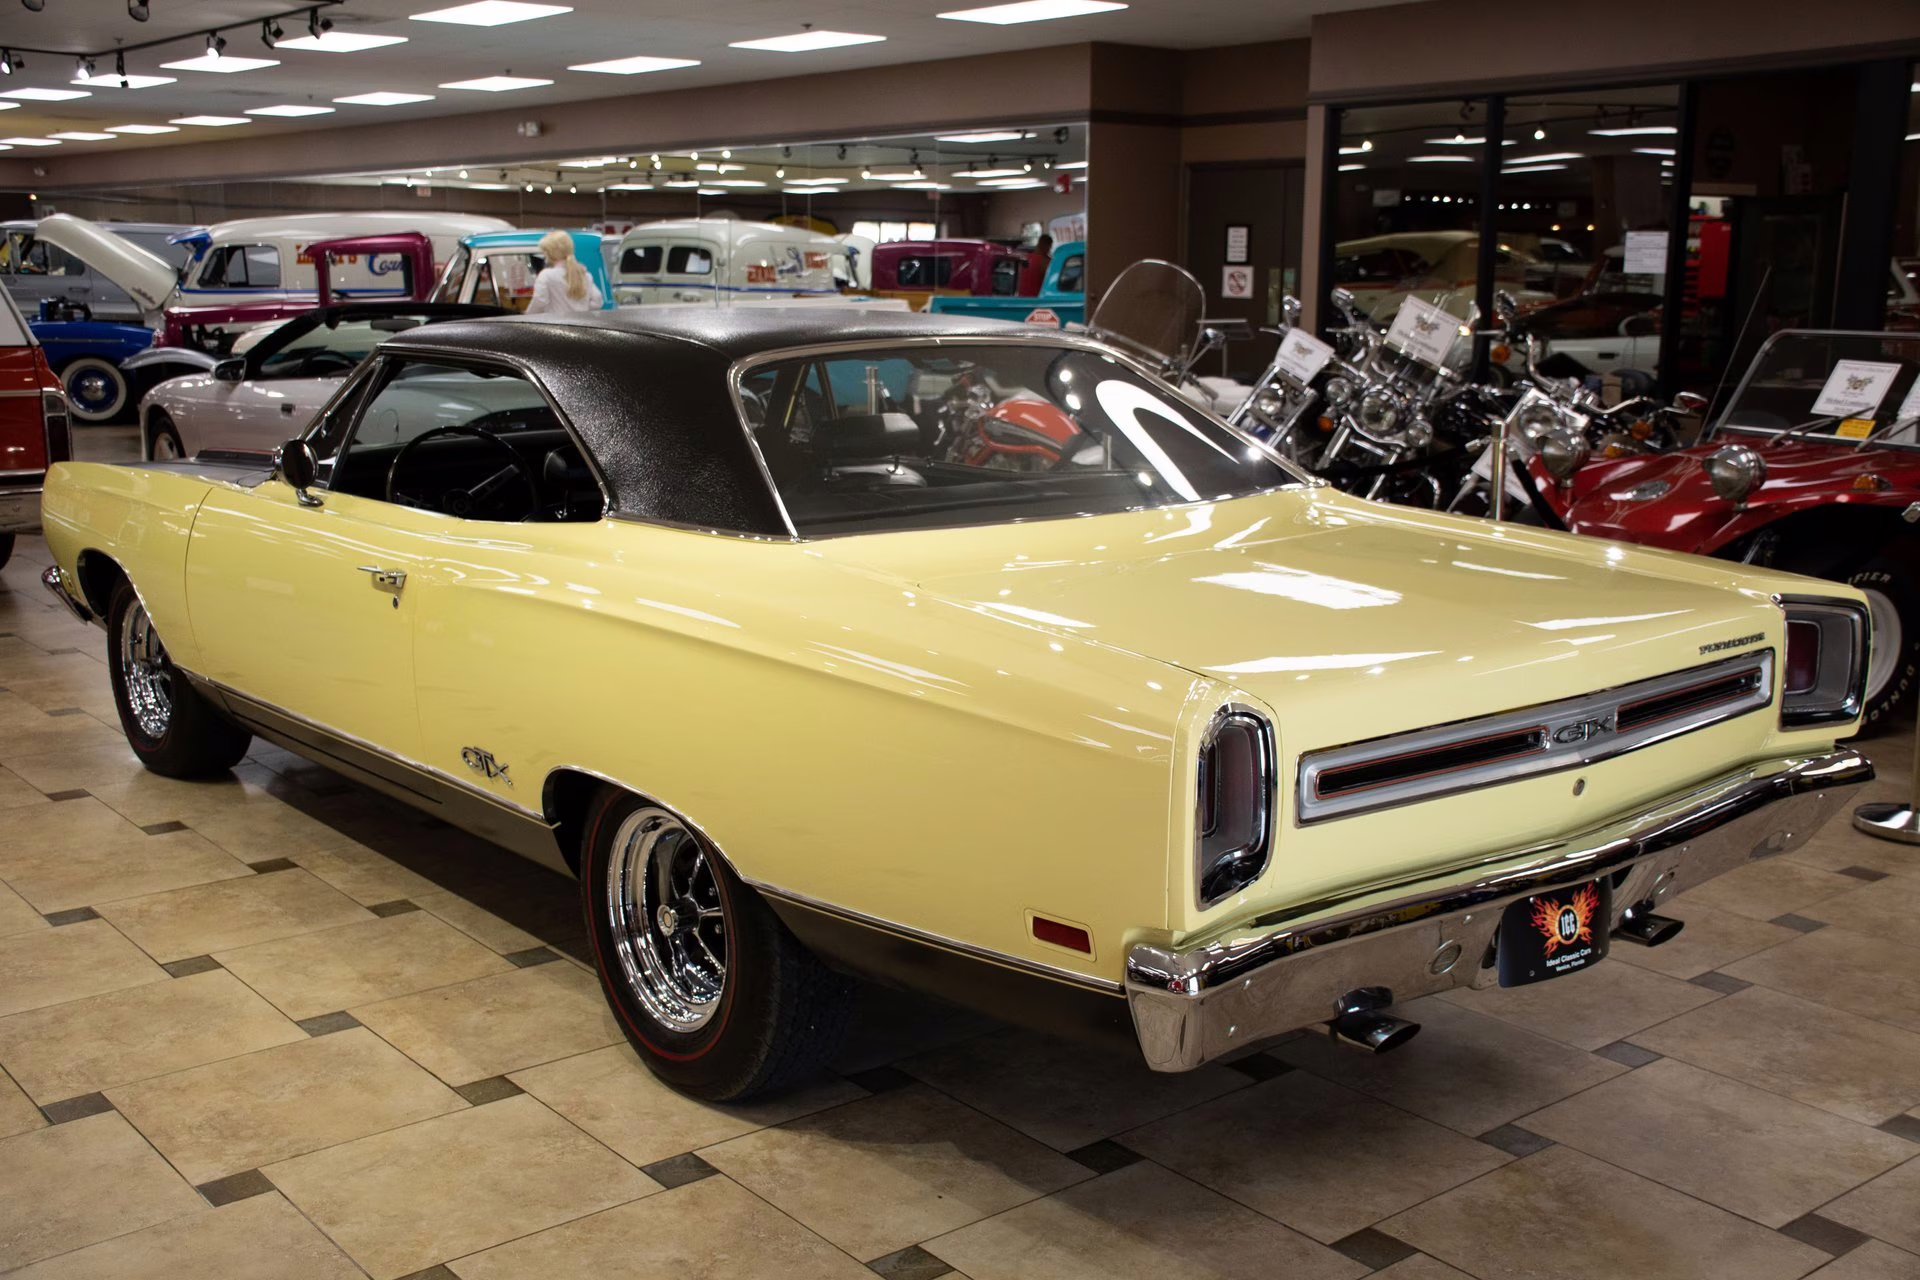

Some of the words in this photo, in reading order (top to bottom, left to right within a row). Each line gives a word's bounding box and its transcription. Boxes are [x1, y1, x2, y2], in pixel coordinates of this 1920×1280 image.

[1699, 632, 1766, 655] PLYMOUTH
[1553, 714, 1613, 744] GTX
[461, 746, 514, 787] GTX
[1560, 911, 1576, 936] ICC
[1546, 957, 1561, 967] Ideal
[1561, 951, 1580, 963] Classic
[1580, 947, 1592, 957] Cars
